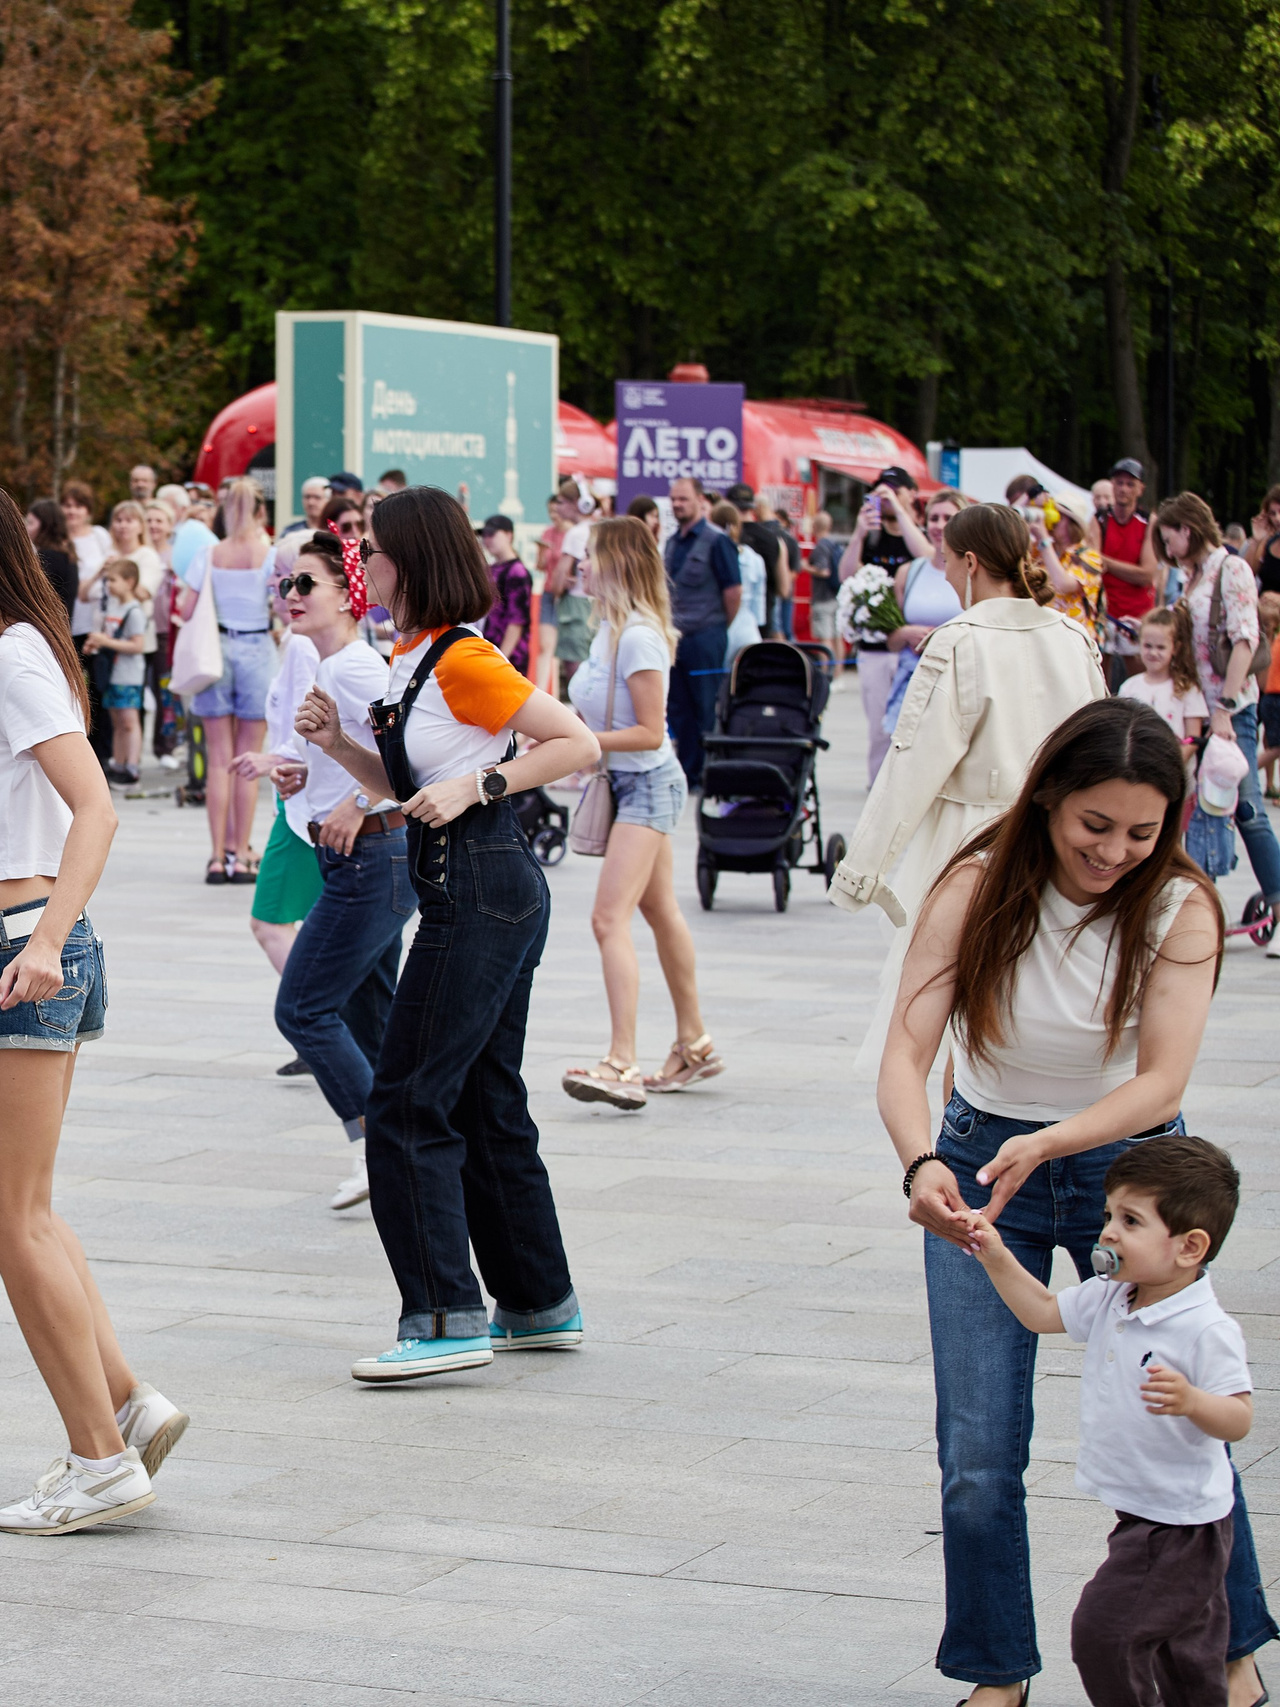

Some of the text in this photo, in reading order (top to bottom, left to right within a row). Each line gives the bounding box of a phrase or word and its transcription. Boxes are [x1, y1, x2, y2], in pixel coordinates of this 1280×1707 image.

[372, 380, 417, 419] День
[624, 427, 738, 460] ЛЕТО
[623, 460, 737, 480] В МОСКВЕ
